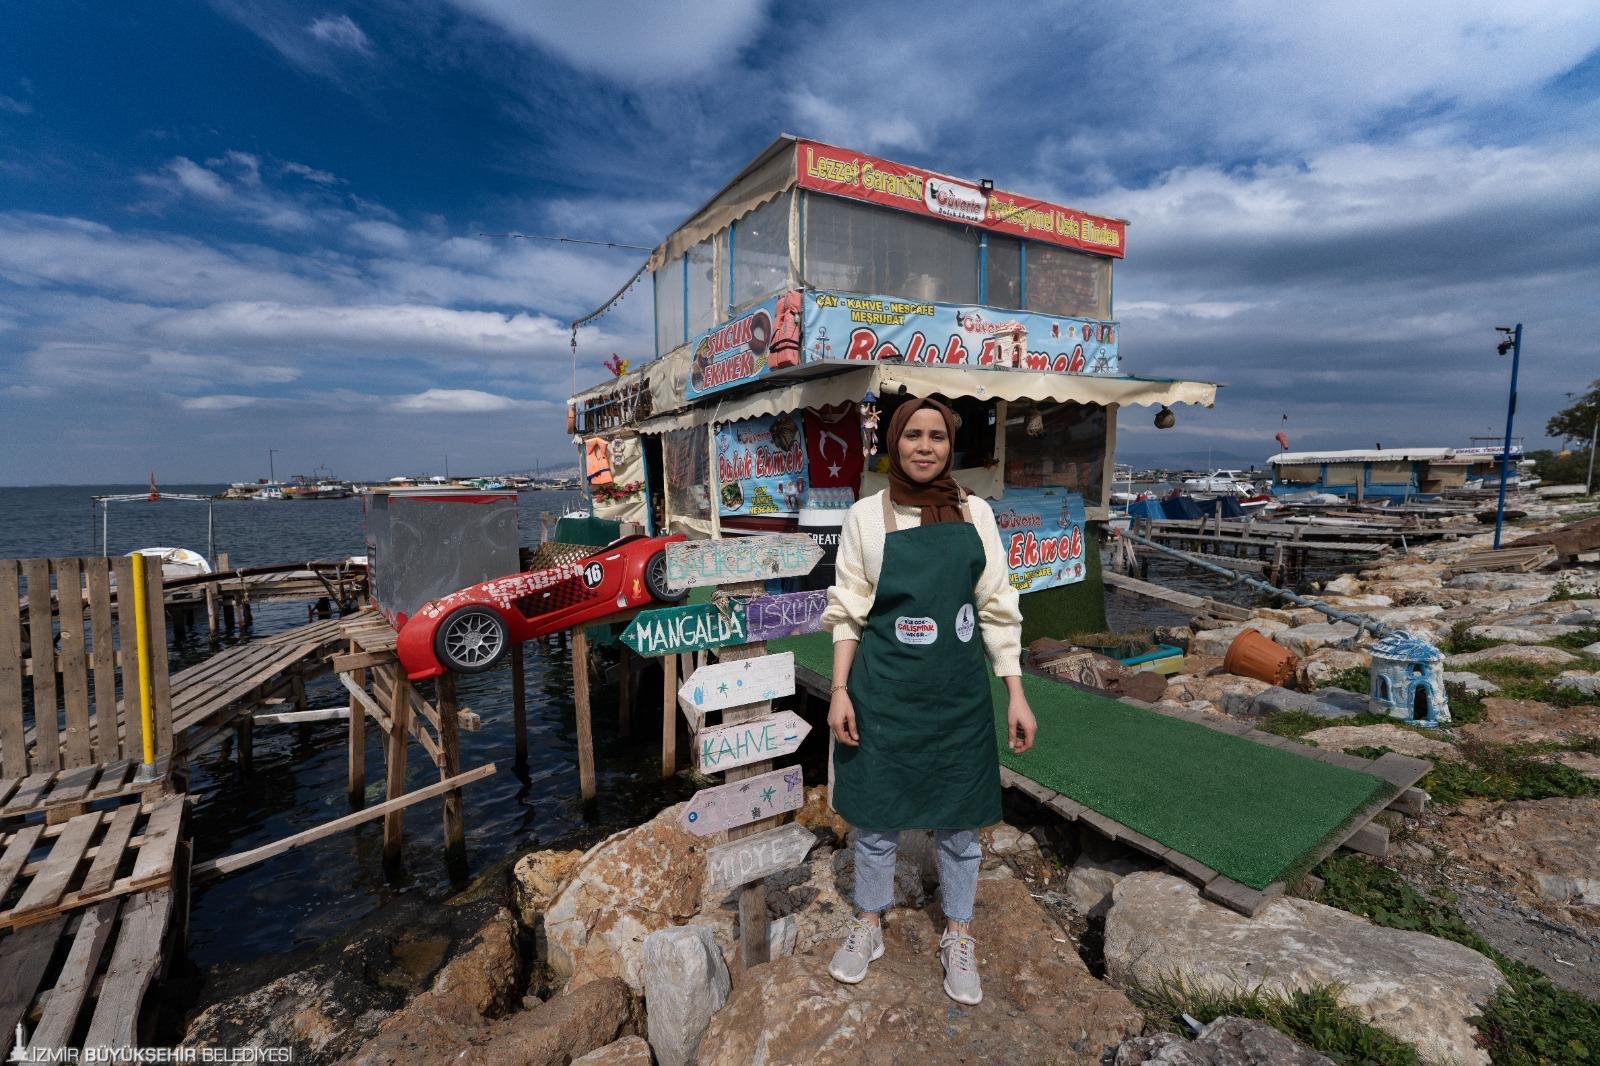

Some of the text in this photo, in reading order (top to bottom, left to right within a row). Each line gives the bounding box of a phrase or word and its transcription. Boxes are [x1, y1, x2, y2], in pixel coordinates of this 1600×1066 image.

[807, 148, 859, 186] Lezzet
[1056, 210, 1080, 240] Usta
[816, 295, 934, 316] ÇAY KAHVE NESCAFE
[851, 310, 905, 325] MEŞRUBAT
[706, 315, 753, 358] SUCUK
[703, 351, 753, 388] EKMEK
[755, 440, 804, 478] Ekmek
[1008, 525, 1082, 570] Ekmek
[585, 564, 602, 586] 16
[636, 610, 744, 652] MANGALDA
[703, 723, 778, 767] KAHVE
